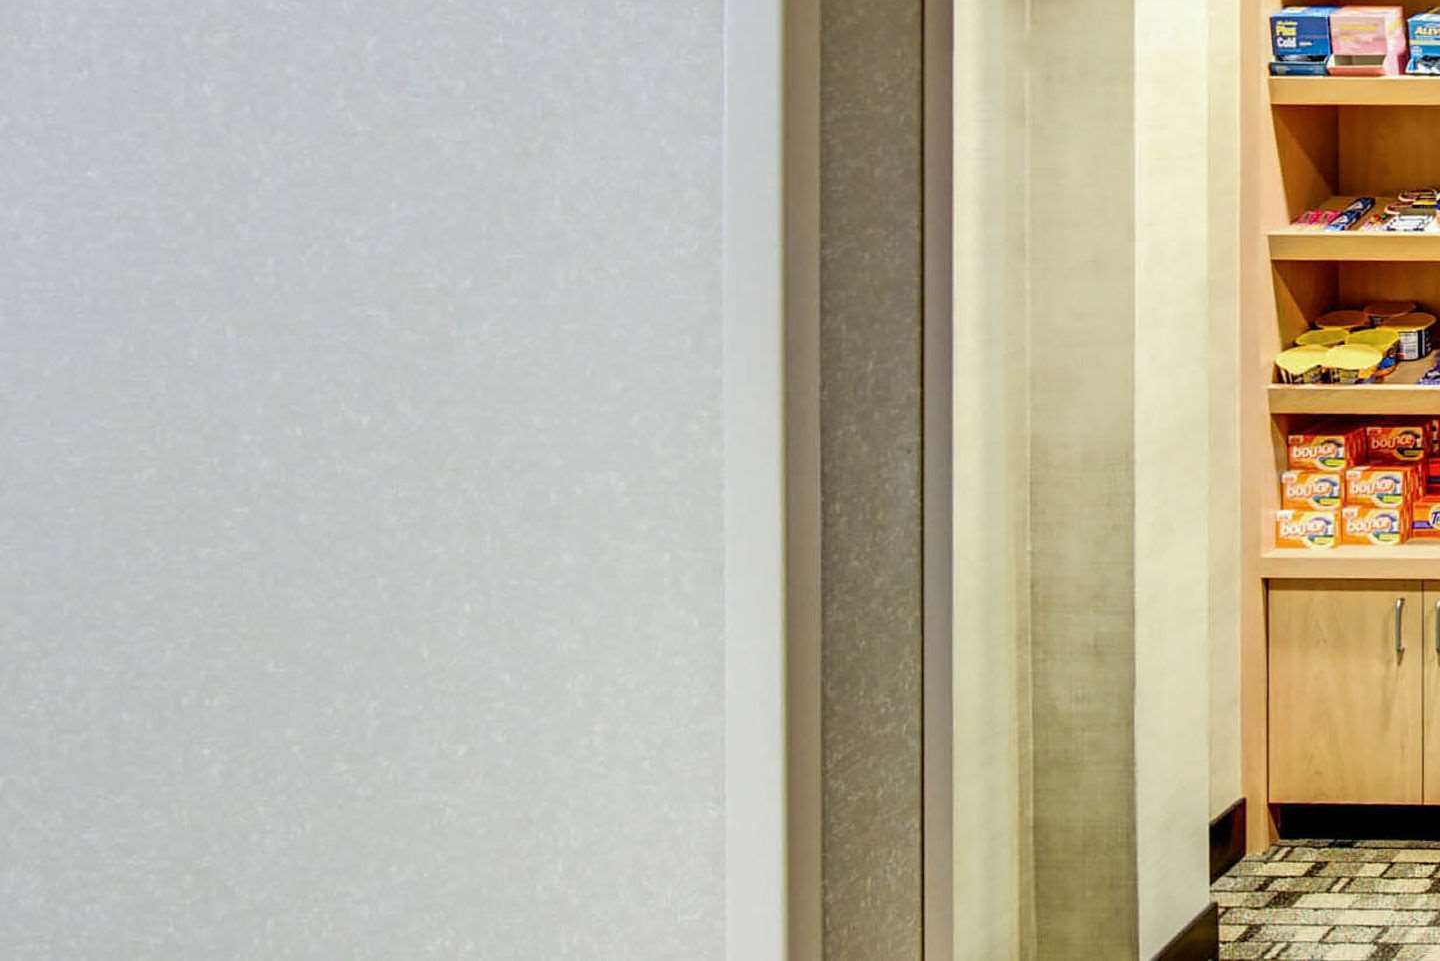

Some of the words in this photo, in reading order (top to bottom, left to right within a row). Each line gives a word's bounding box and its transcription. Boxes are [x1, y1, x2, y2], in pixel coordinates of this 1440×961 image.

[1371, 434, 1414, 449] bounce
[1292, 444, 1336, 458] bounce
[1287, 482, 1331, 496] bounce
[1352, 480, 1395, 494] bounce
[1281, 521, 1325, 535] bounce
[1349, 518, 1392, 532] bounce
